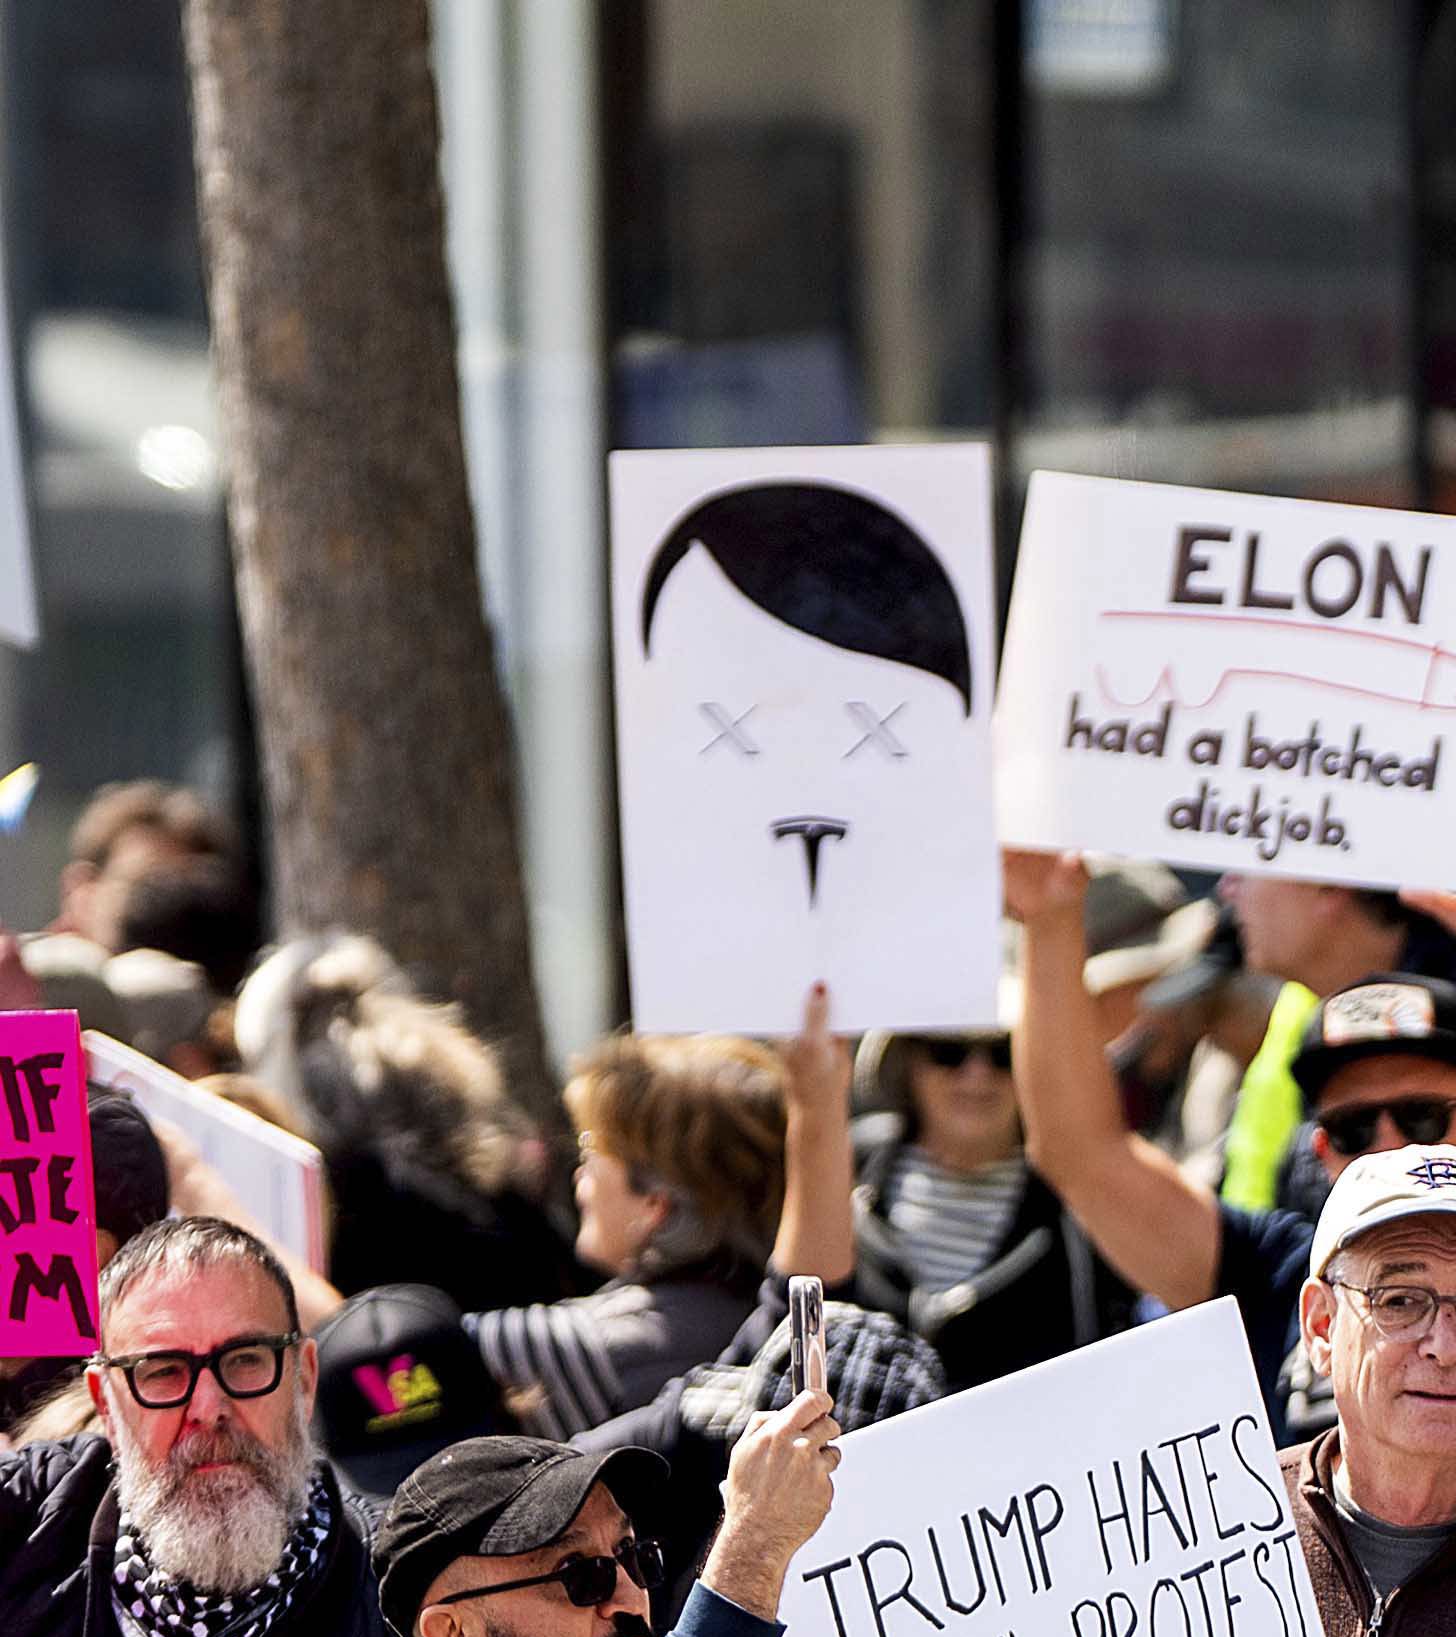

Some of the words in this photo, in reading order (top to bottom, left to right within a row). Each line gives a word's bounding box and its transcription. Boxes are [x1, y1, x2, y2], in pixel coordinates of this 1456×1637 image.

[1167, 525, 1433, 625] ELON
[1065, 694, 1173, 758] had
[1188, 731, 1225, 767] a
[1242, 712, 1443, 792] botched
[1087, 1413, 1286, 1576] HATES
